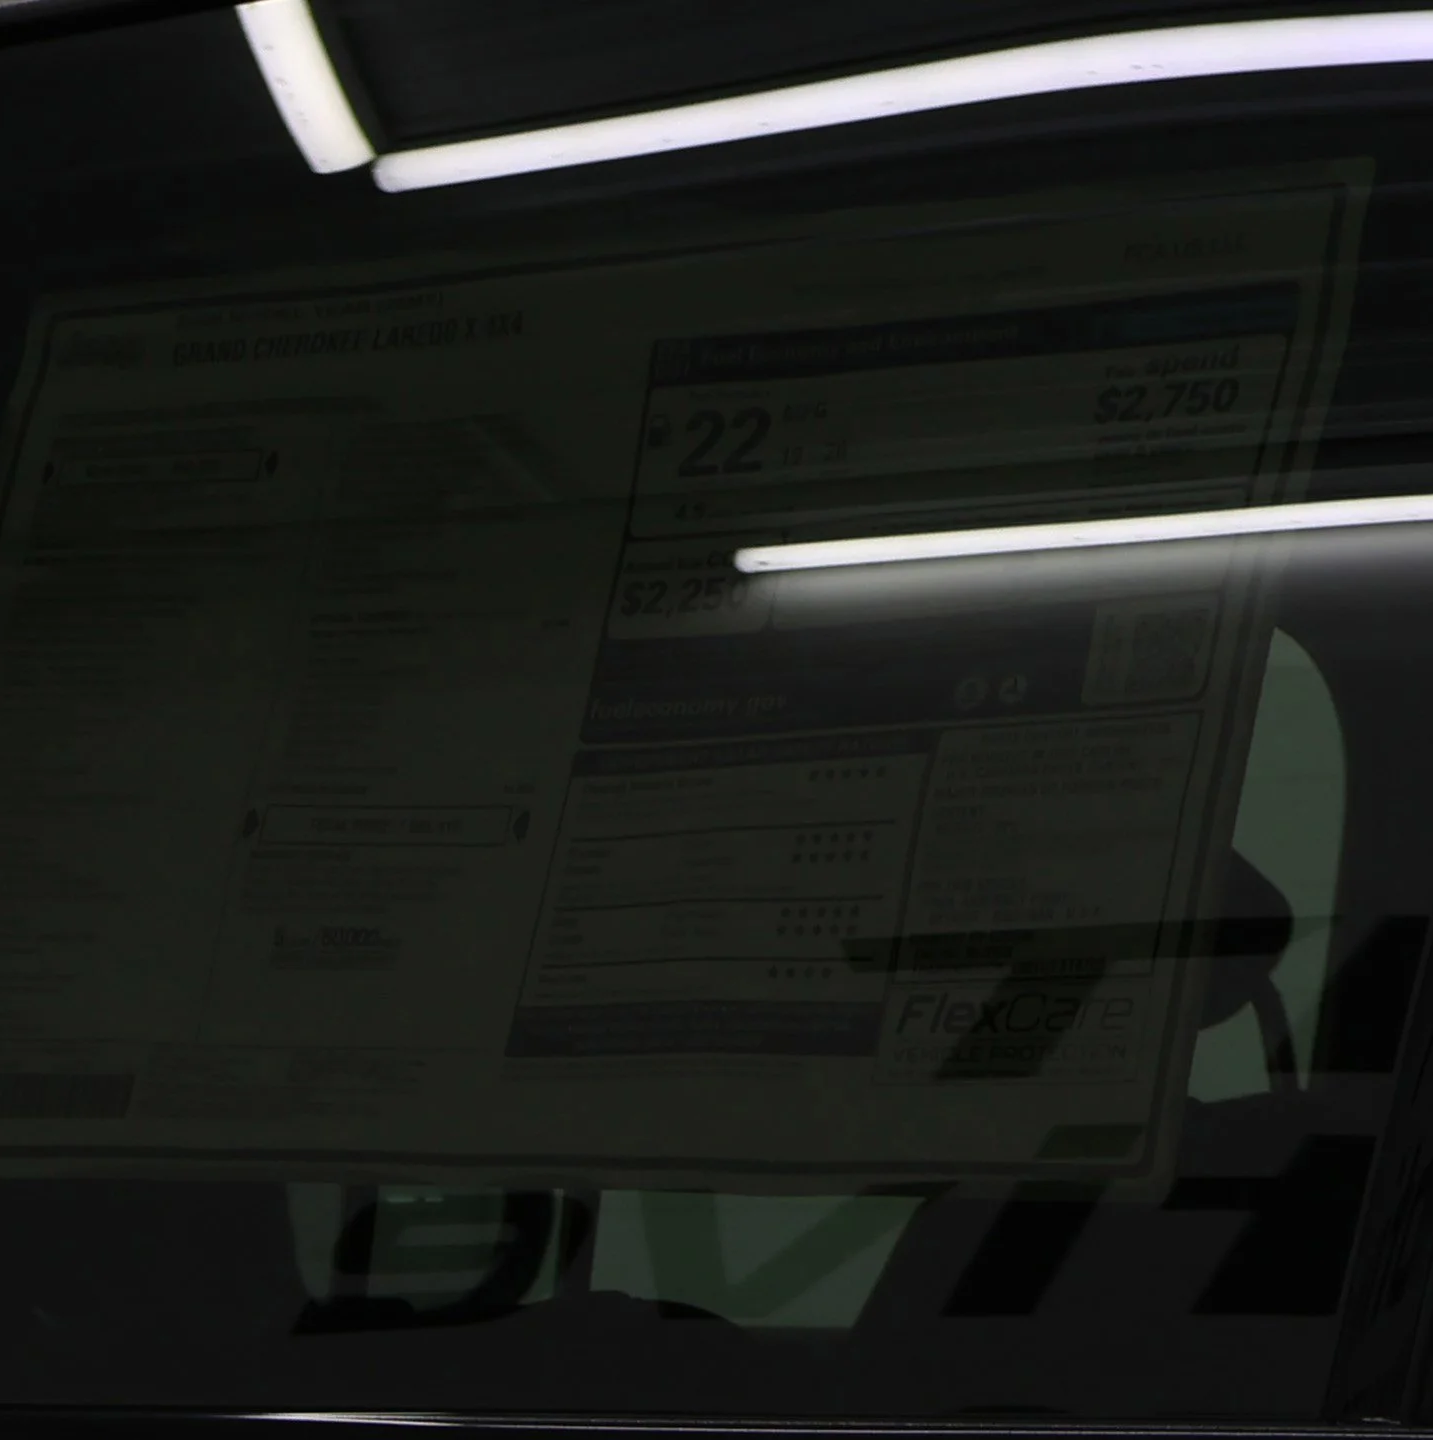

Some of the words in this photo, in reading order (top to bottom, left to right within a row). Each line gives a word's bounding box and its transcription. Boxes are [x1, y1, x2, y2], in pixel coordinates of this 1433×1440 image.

[172, 337, 246, 368] GRAND
[253, 328, 365, 361] CHEROKEE
[1092, 377, 1241, 425] $2,750
[677, 406, 773, 478] 22
[895, 992, 1135, 1035] FlexCare
